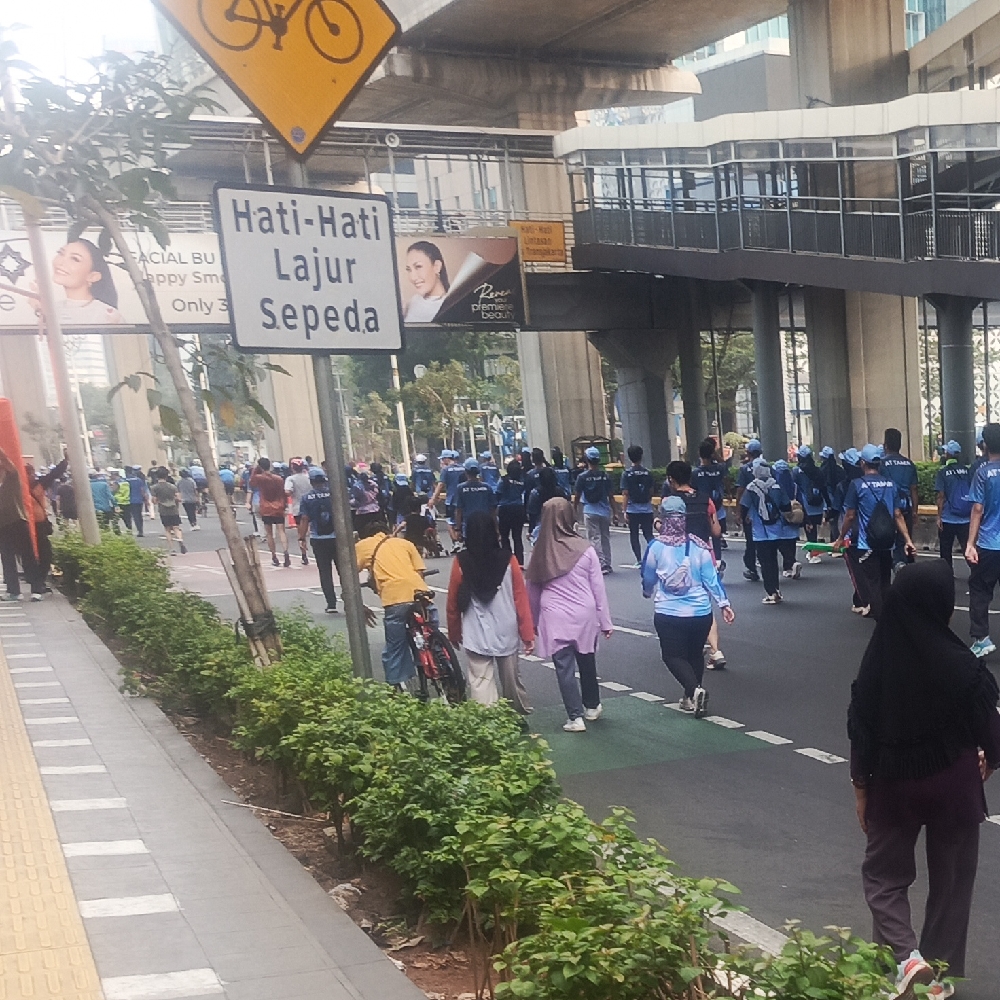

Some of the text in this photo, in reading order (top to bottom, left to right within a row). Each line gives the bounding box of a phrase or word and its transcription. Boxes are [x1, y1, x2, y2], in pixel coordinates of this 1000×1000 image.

[232, 199, 380, 240] Hati-Hati
[147, 273, 187, 286] appy
[274, 247, 356, 291] Lajur
[172, 298, 213, 315] Only
[260, 297, 380, 340] Sepeda
[987, 469, 997, 478] AT
